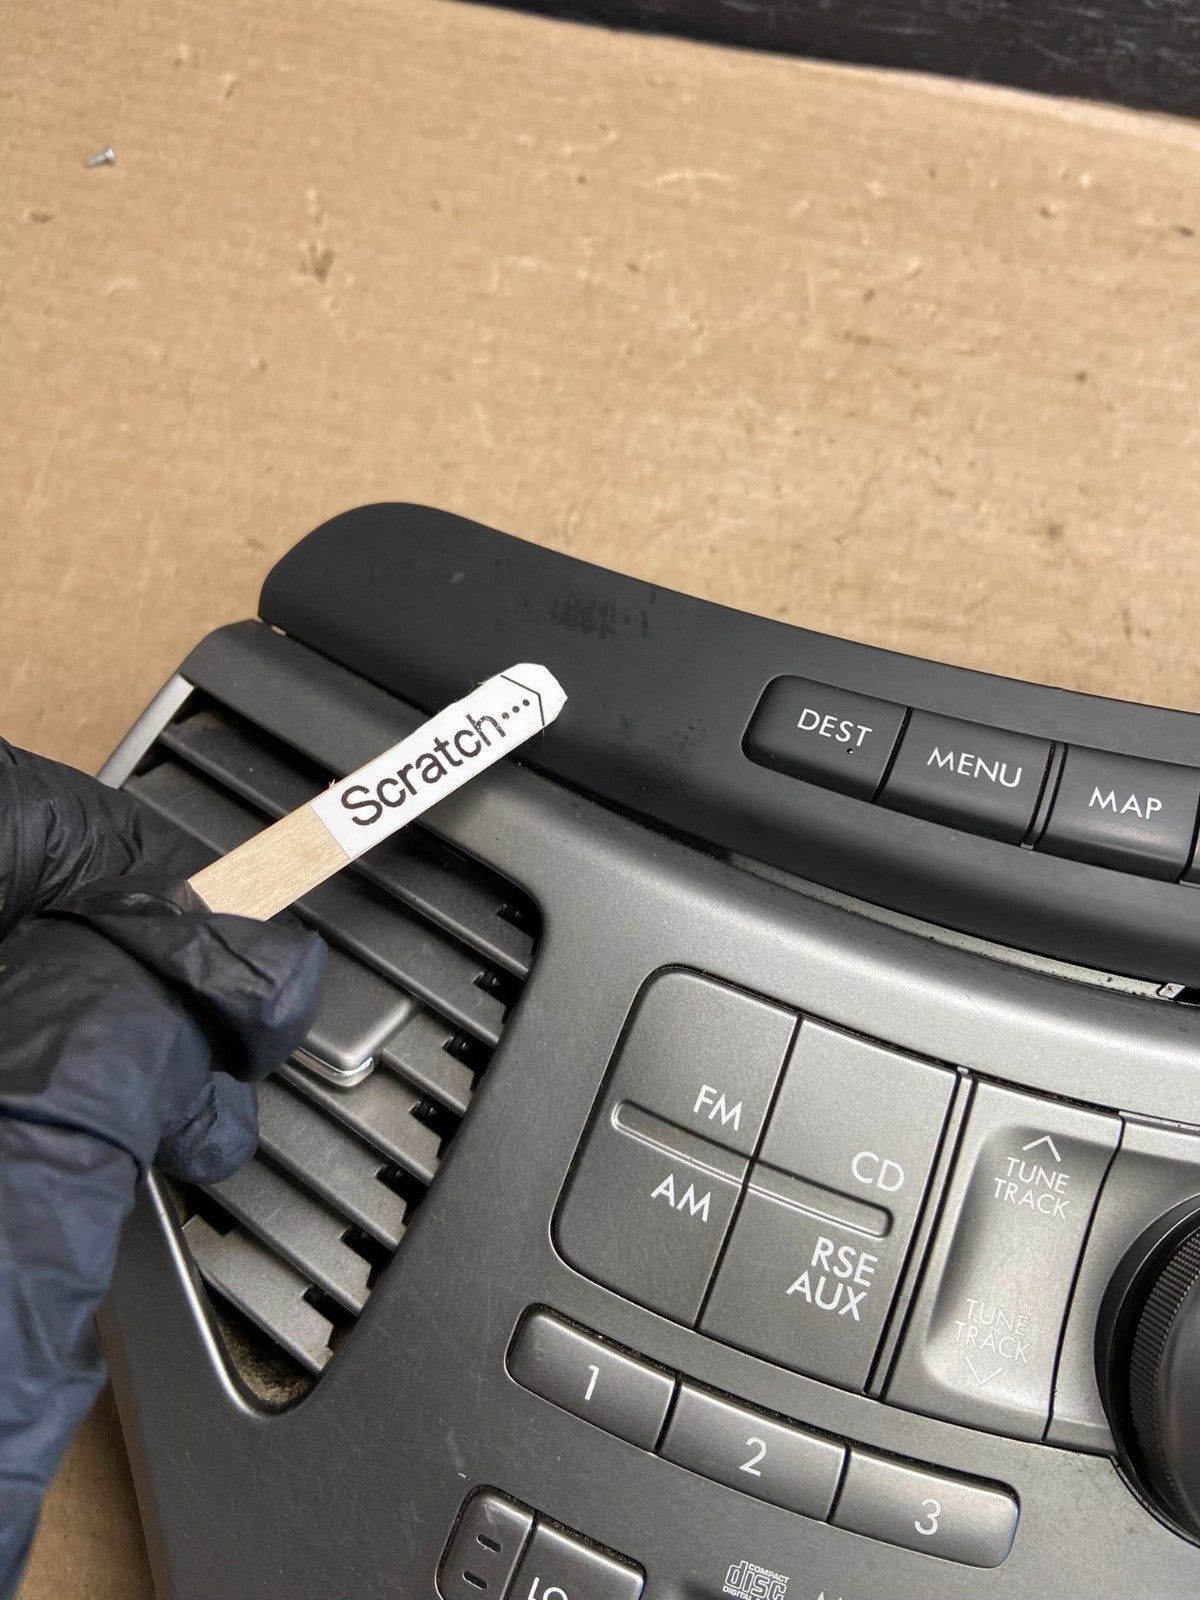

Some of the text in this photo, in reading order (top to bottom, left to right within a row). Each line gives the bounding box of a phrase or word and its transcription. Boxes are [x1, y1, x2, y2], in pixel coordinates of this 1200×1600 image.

[797, 708, 873, 747] DEST
[926, 747, 1023, 788] MENU
[1088, 787, 1162, 820] MAP
[692, 1084, 743, 1131] FM
[851, 1151, 905, 1192] CD
[1006, 1156, 1070, 1195] TUNE
[650, 1173, 711, 1222] AM
[994, 1177, 1070, 1220] TRACK
[810, 1236, 878, 1287] RSE
[785, 1270, 868, 1321] AUX
[966, 1298, 1029, 1336] TUNE
[954, 1320, 1031, 1365] TRACK
[584, 1364, 600, 1401] 1
[739, 1437, 767, 1477] 2
[914, 1498, 942, 1536] 3
[748, 1563, 790, 1584] COMPACT
